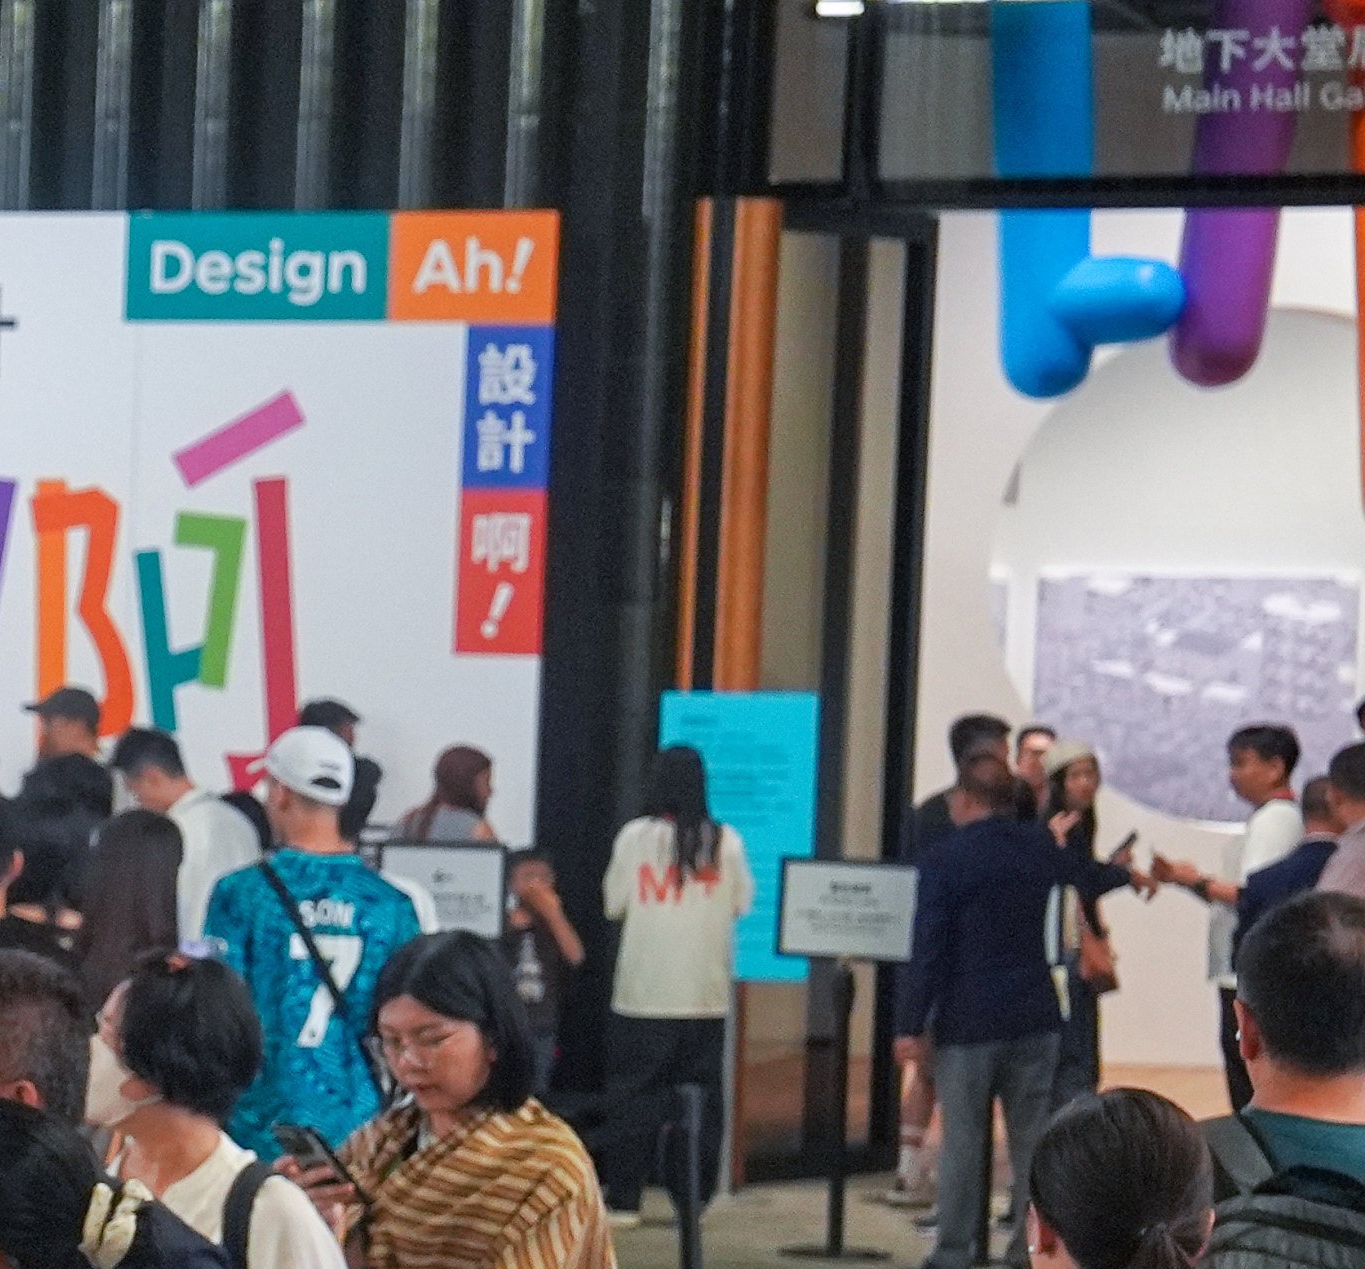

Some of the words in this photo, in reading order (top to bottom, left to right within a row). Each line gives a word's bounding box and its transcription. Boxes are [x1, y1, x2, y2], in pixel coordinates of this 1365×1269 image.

[1162, 82, 1242, 113] Main
[1249, 81, 1310, 113] Hall
[149, 239, 369, 306] Design
[413, 236, 535, 295] Ah!
[298, 898, 357, 929] SON
[288, 932, 365, 1048] 7
